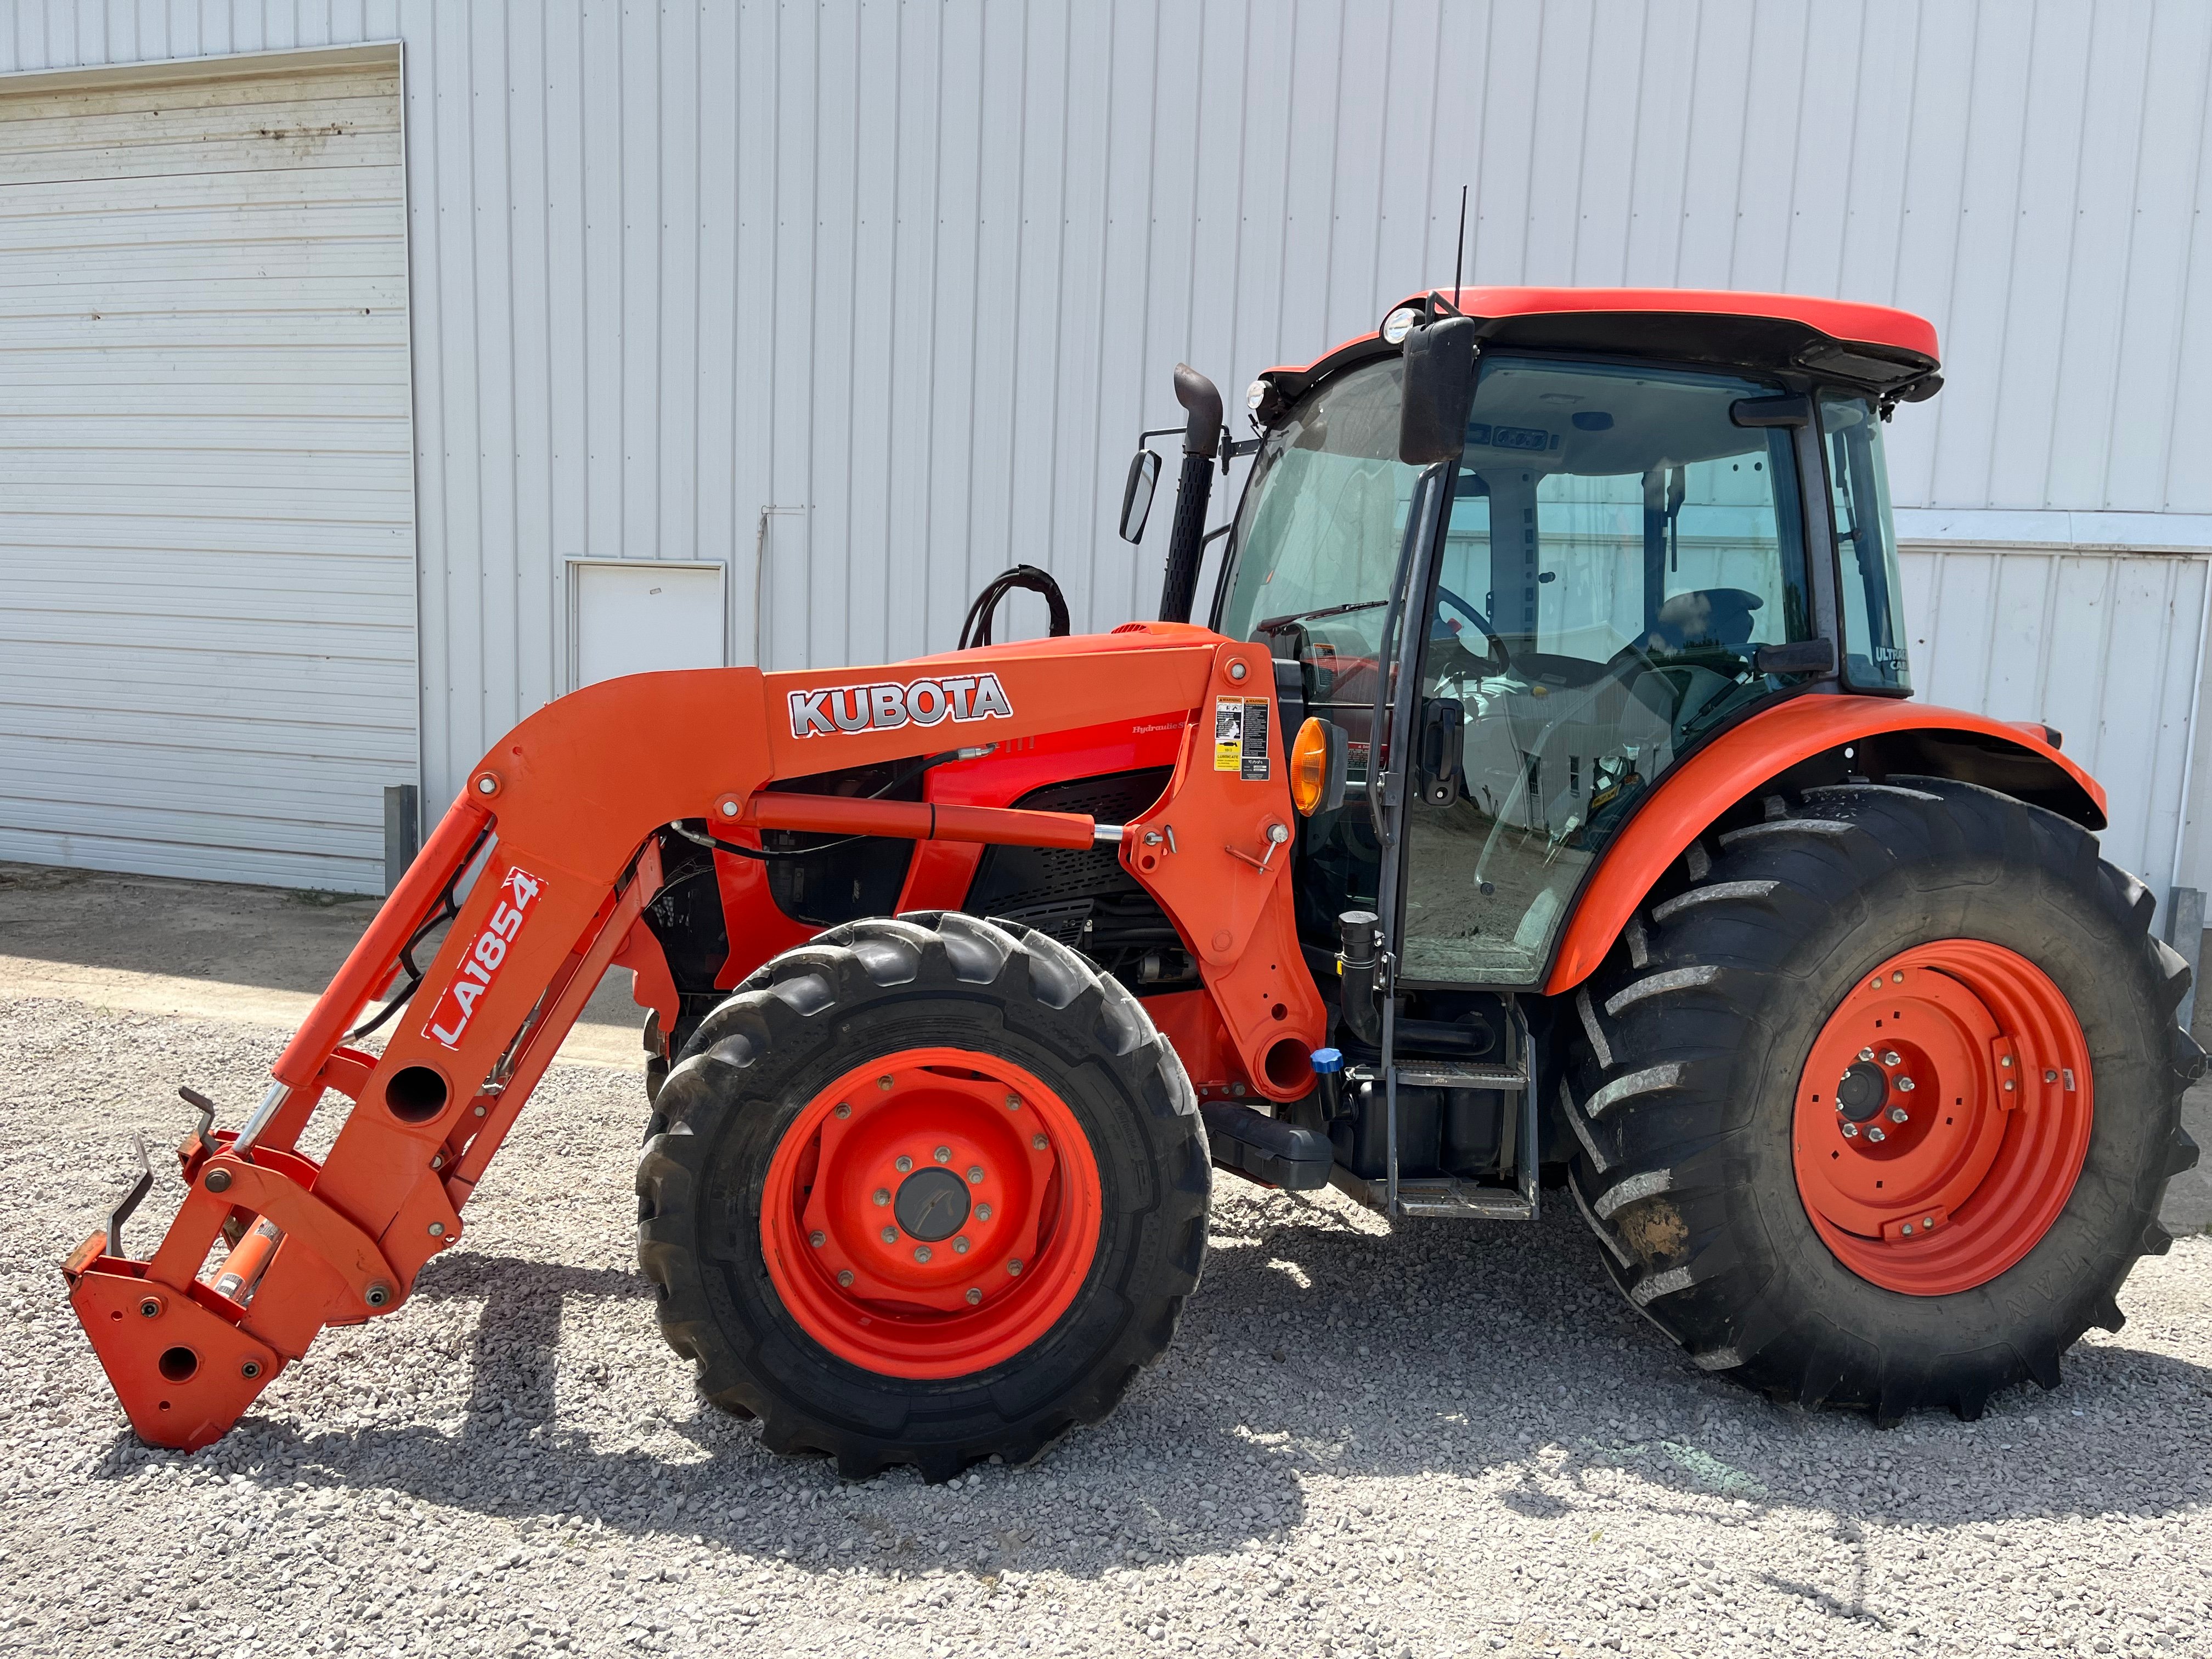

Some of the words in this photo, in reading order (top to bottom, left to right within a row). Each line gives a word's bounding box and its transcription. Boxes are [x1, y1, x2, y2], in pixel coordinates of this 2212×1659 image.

[790, 675, 1011, 736] KUBOTA
[1132, 723, 1177, 734] Hydraulic
[431, 872, 540, 1045] LA1854
[2005, 1191, 2119, 1327] TITAN
